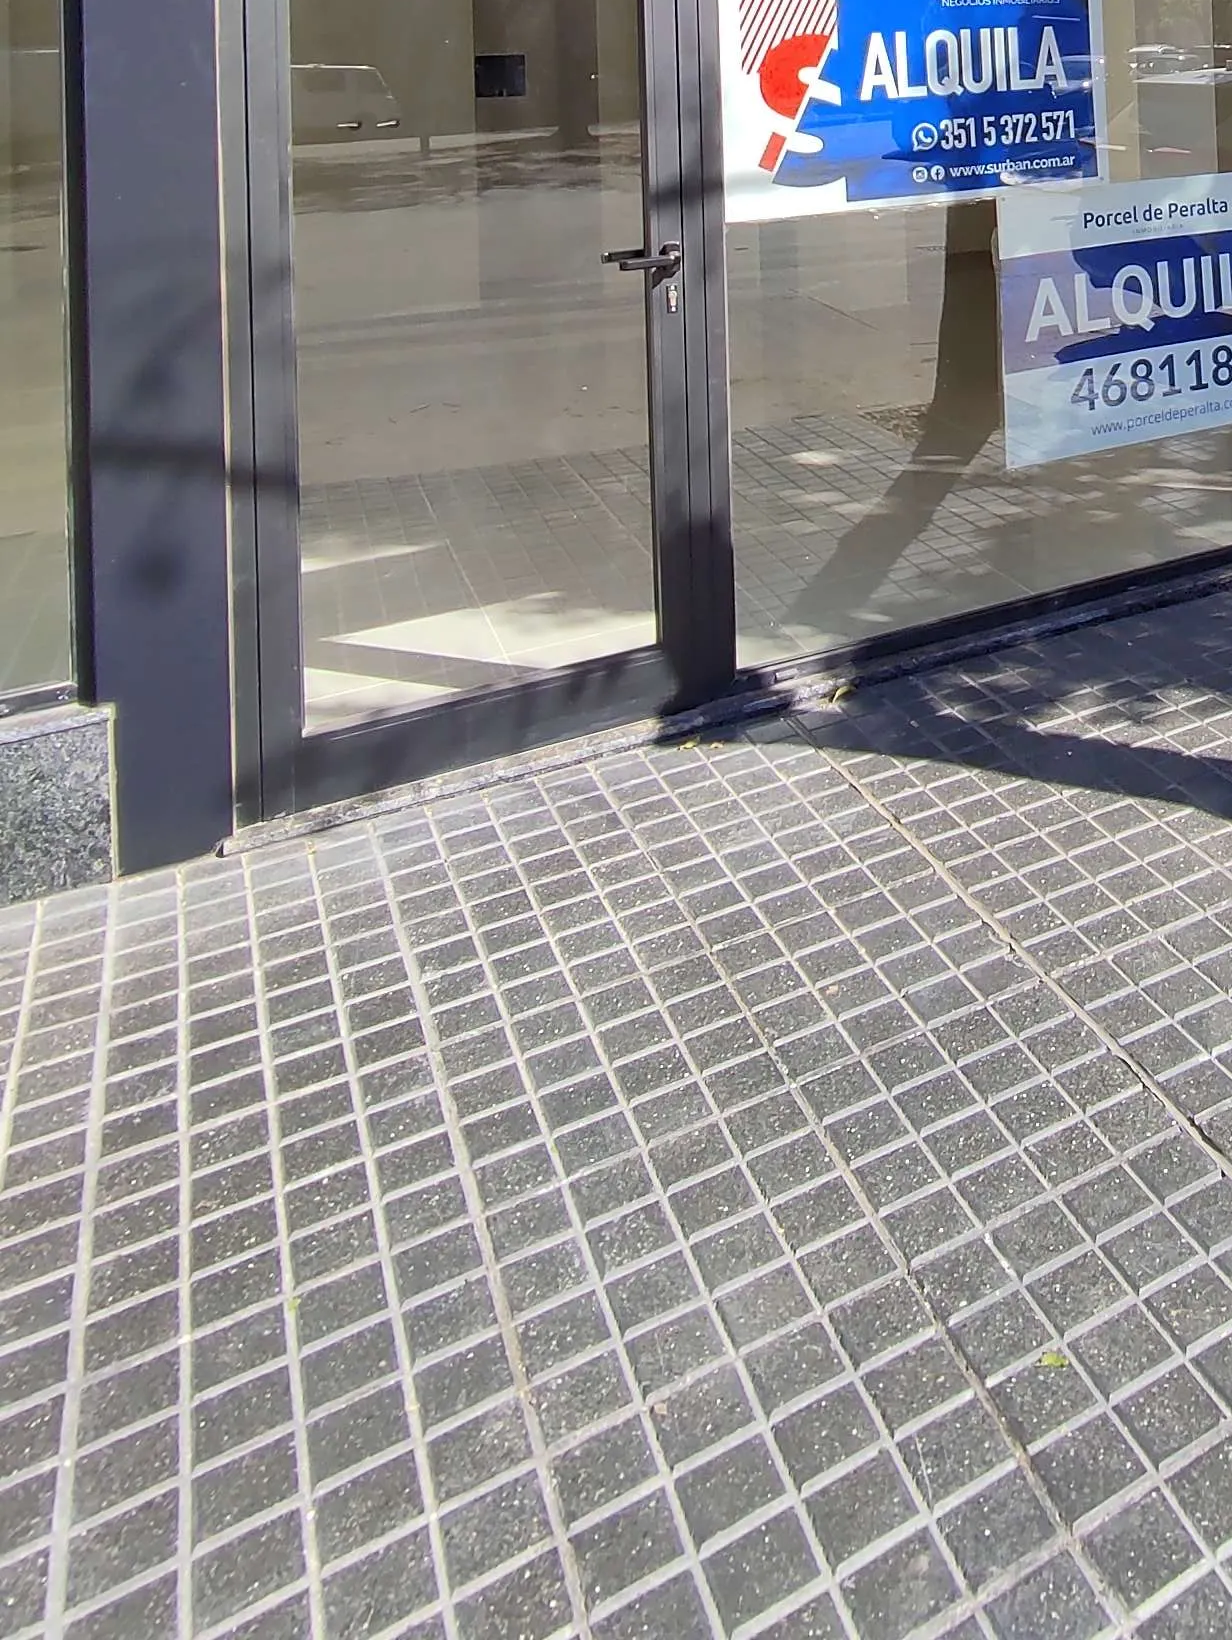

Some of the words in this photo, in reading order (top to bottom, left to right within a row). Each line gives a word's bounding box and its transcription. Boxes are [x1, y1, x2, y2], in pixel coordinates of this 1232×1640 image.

[860, 25, 1068, 101] ALQUILA
[940, 117, 977, 150] 351
[983, 116, 996, 147] 5
[1000, 112, 1038, 145] 372
[1041, 109, 1075, 140] 571
[949, 154, 1076, 178] www.surban.com.ar
[1083, 205, 1139, 229] Porcel
[1142, 203, 1163, 222] de
[1168, 197, 1228, 219] Peralta
